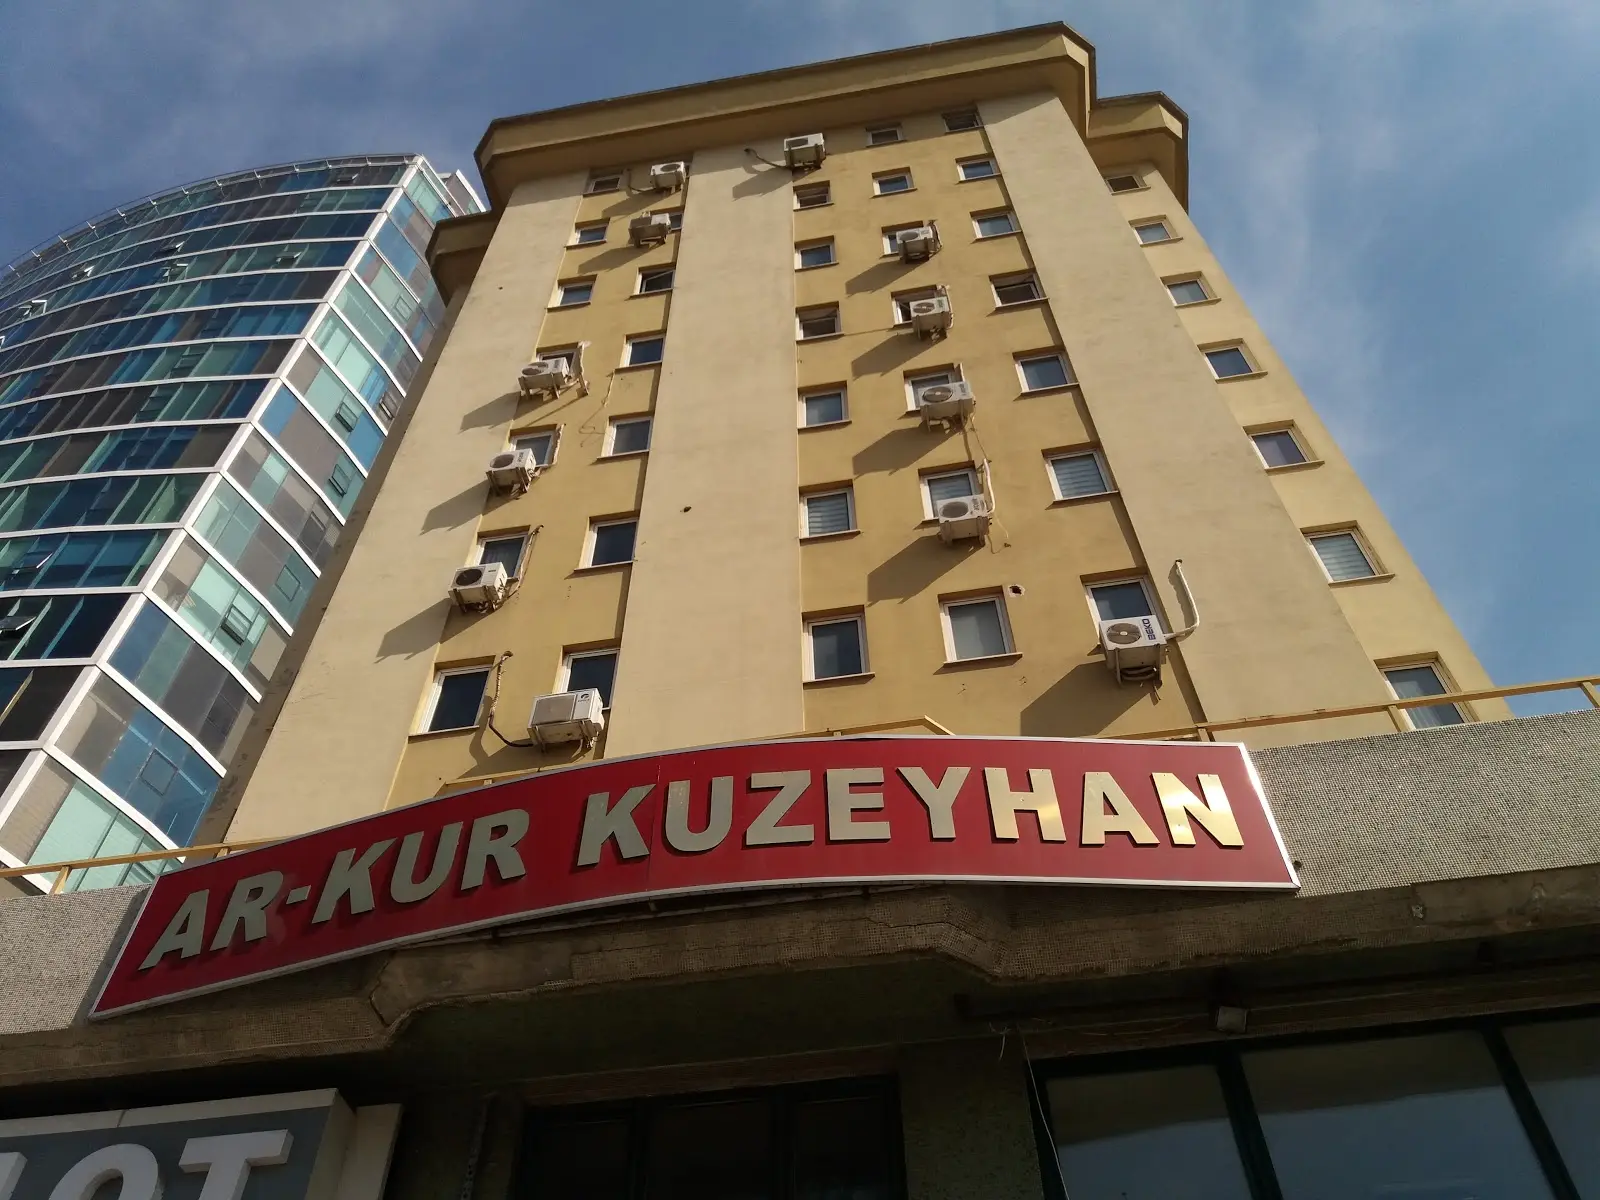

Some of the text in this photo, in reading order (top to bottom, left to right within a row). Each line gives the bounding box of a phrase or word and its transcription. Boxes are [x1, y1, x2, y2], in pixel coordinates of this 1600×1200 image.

[1141, 618, 1157, 641] BEKO
[138, 767, 1246, 971] AR-KUR KUZEYHAN
